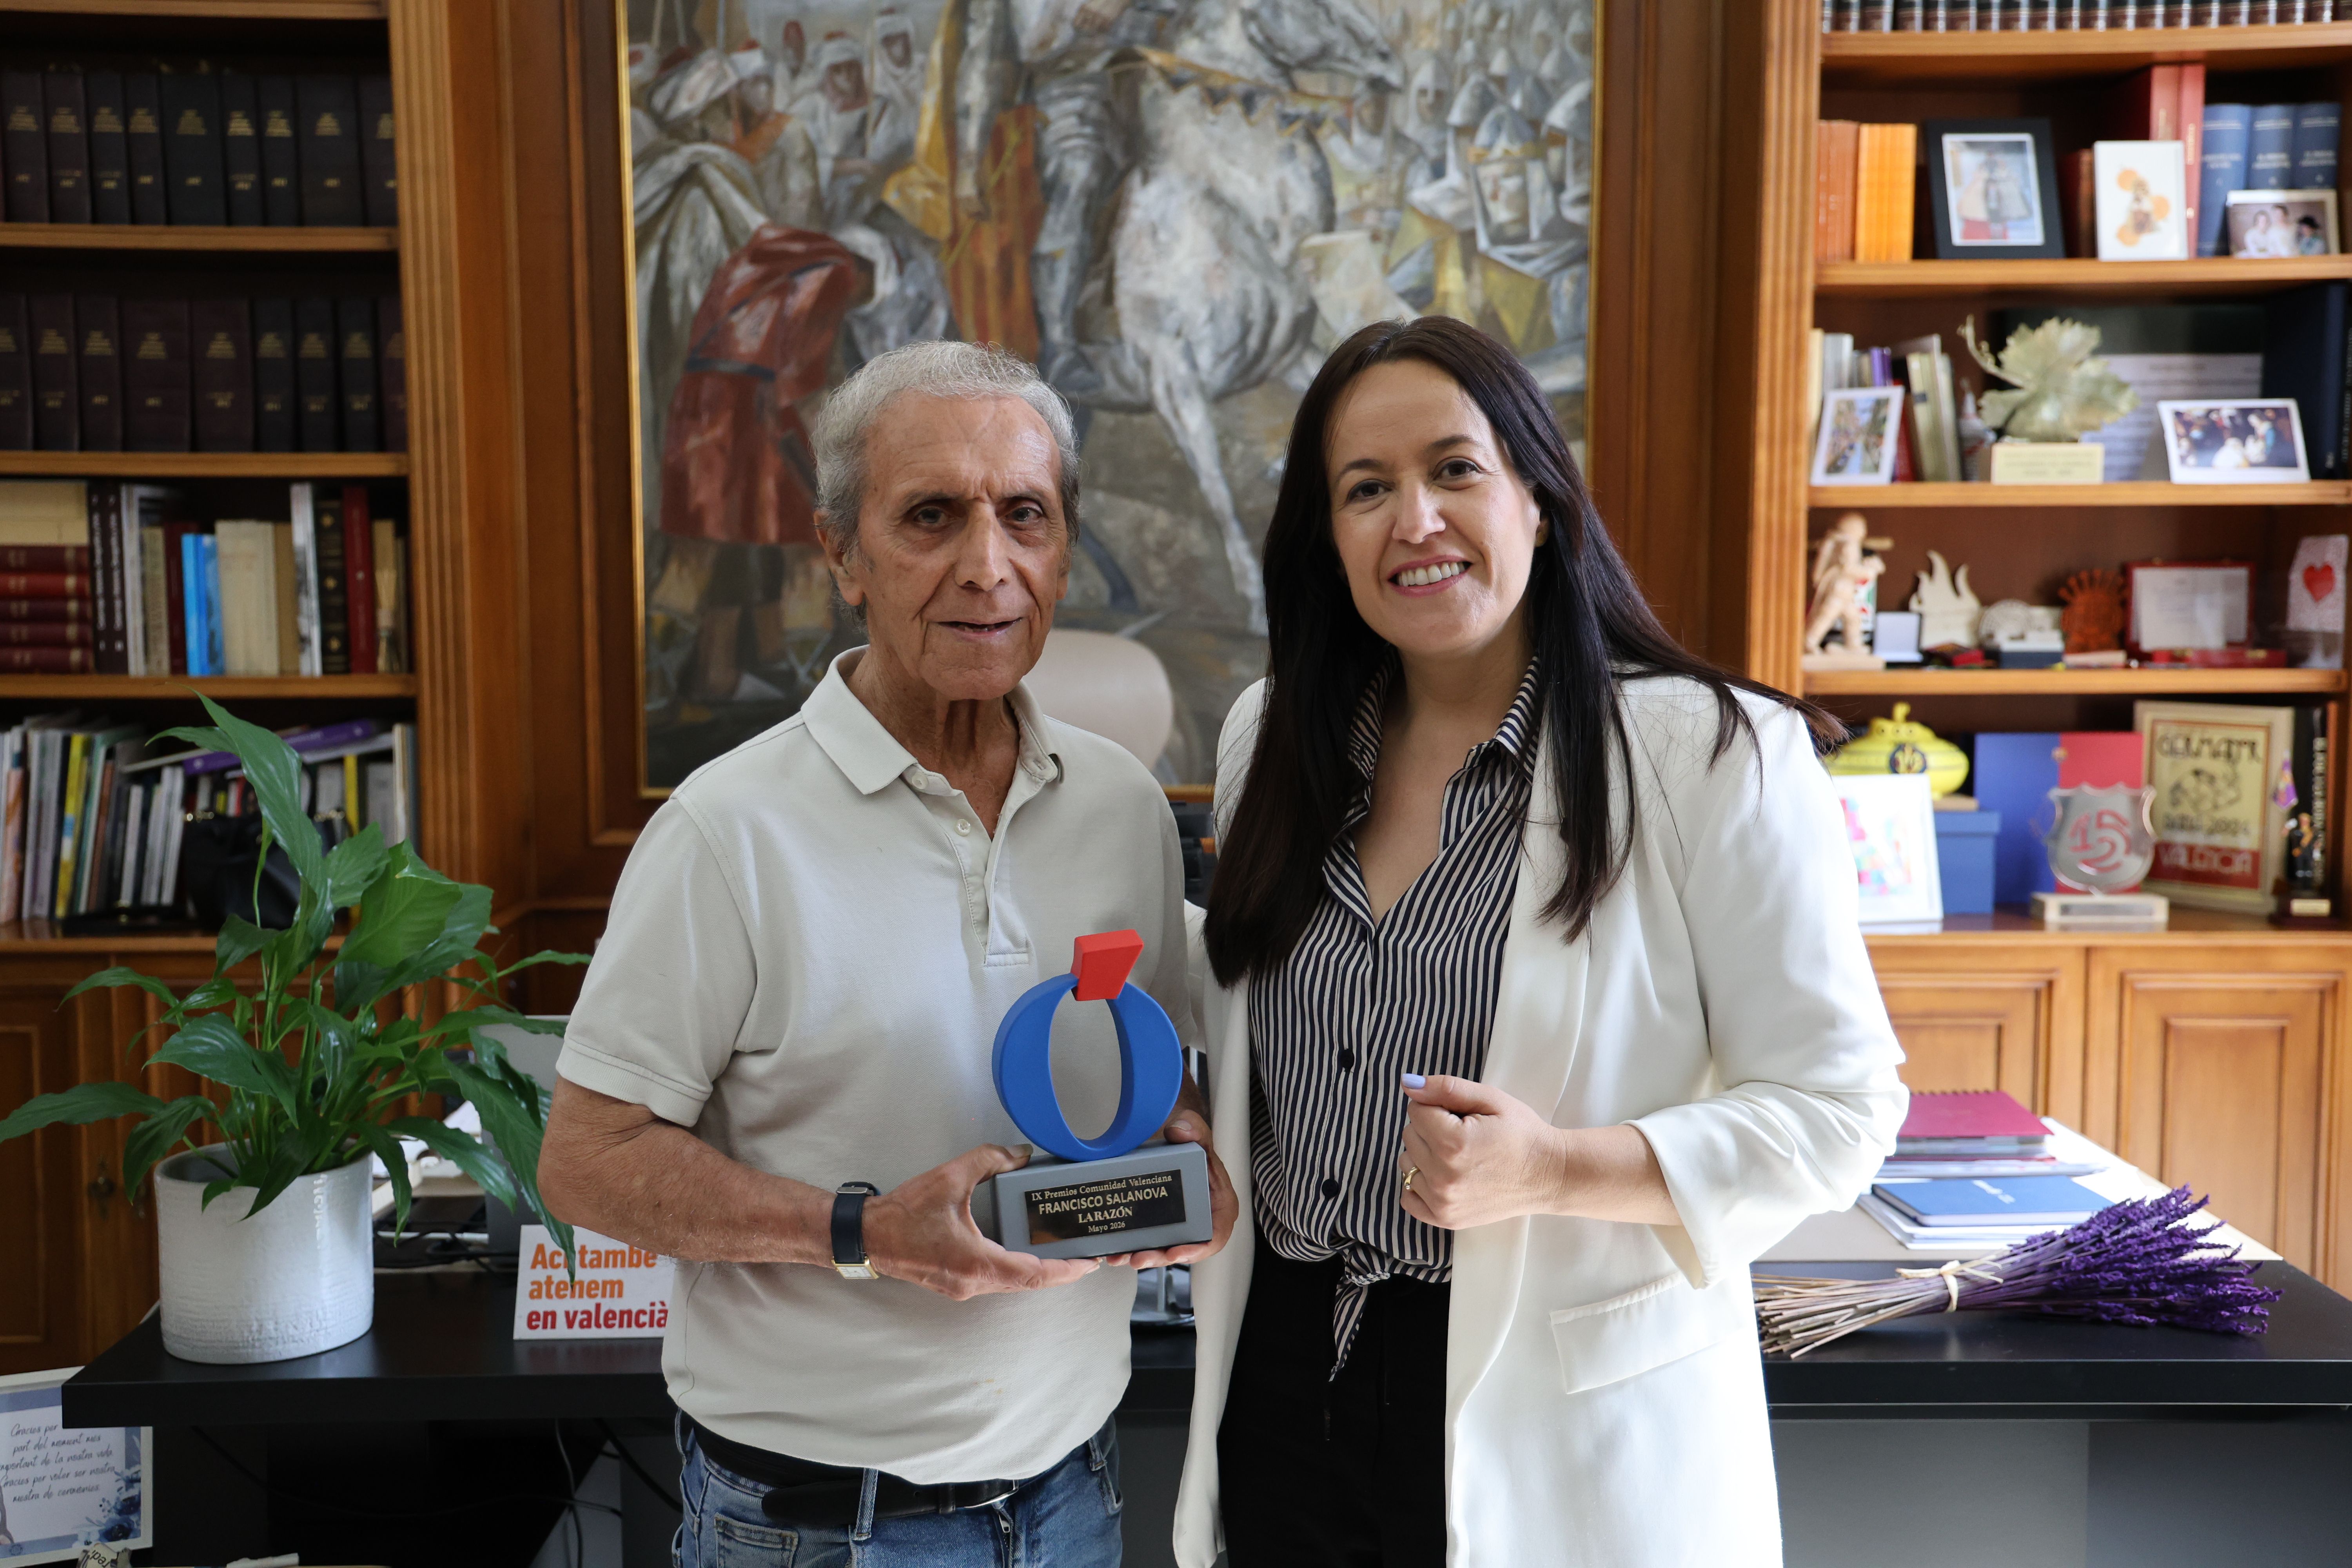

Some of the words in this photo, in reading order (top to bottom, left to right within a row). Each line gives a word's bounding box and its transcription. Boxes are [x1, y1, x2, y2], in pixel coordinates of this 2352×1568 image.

[1031, 1192, 1042, 1201] IX
[1044, 1188, 1078, 1199] Premios
[1080, 1180, 1127, 1194] Comunidad
[1129, 1175, 1172, 1187] Valenciana
[1039, 1196, 1103, 1215] FRANCISCO
[1106, 1186, 1168, 1205] SALANOVA
[1110, 1221, 1126, 1229] 2026
[529, 1275, 624, 1299] atenem
[526, 1310, 557, 1330] en
[564, 1301, 668, 1330] valencià
[44, 1425, 58, 1436] per
[13, 1439, 31, 1457] part
[33, 1436, 48, 1450] del
[0, 1455, 38, 1475] mportant
[41, 1452, 50, 1466] de
[55, 1452, 63, 1463] la
[32, 1475, 46, 1487] per
[43, 1484, 53, 1499] de
